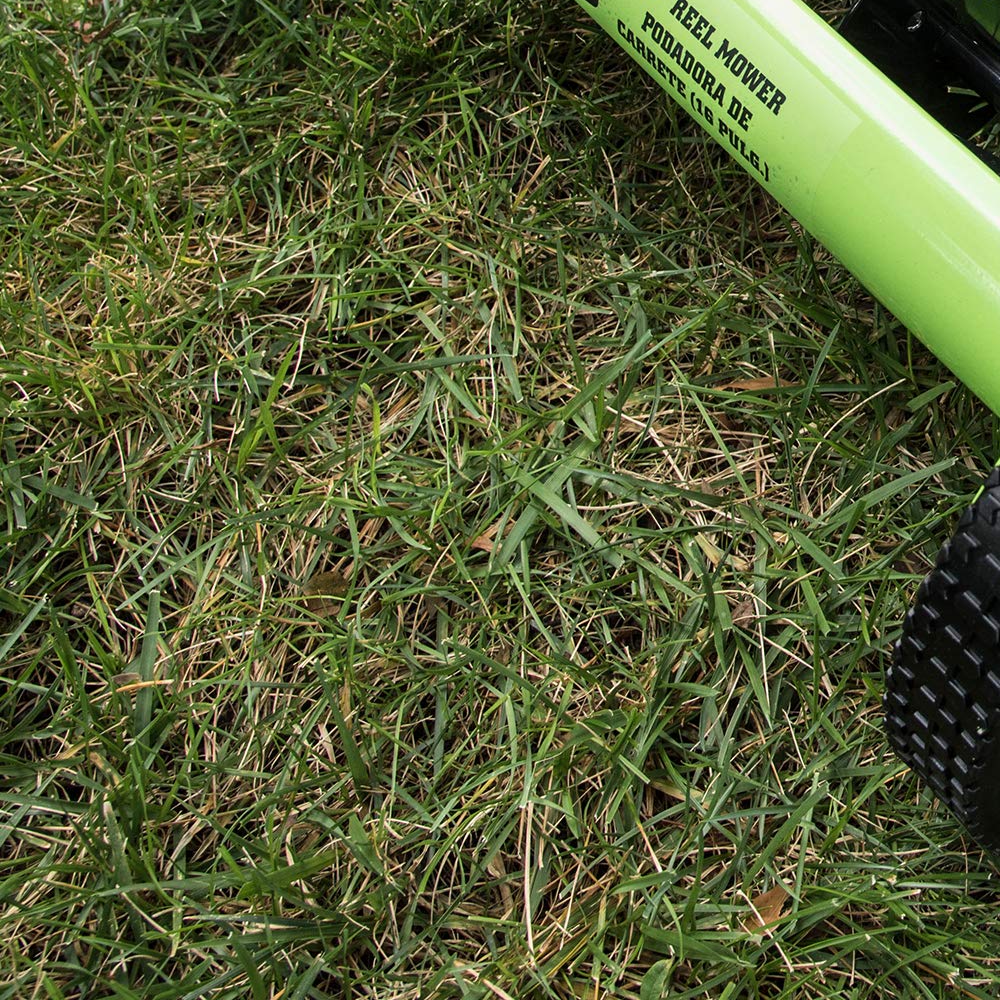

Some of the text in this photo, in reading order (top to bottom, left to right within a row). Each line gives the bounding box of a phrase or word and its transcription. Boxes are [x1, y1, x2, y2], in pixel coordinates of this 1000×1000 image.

[617, 18, 769, 182] CARRETE (16 PULG.)
[641, 11, 754, 131] PODADORA DE
[714, 38, 787, 116] MOWER
